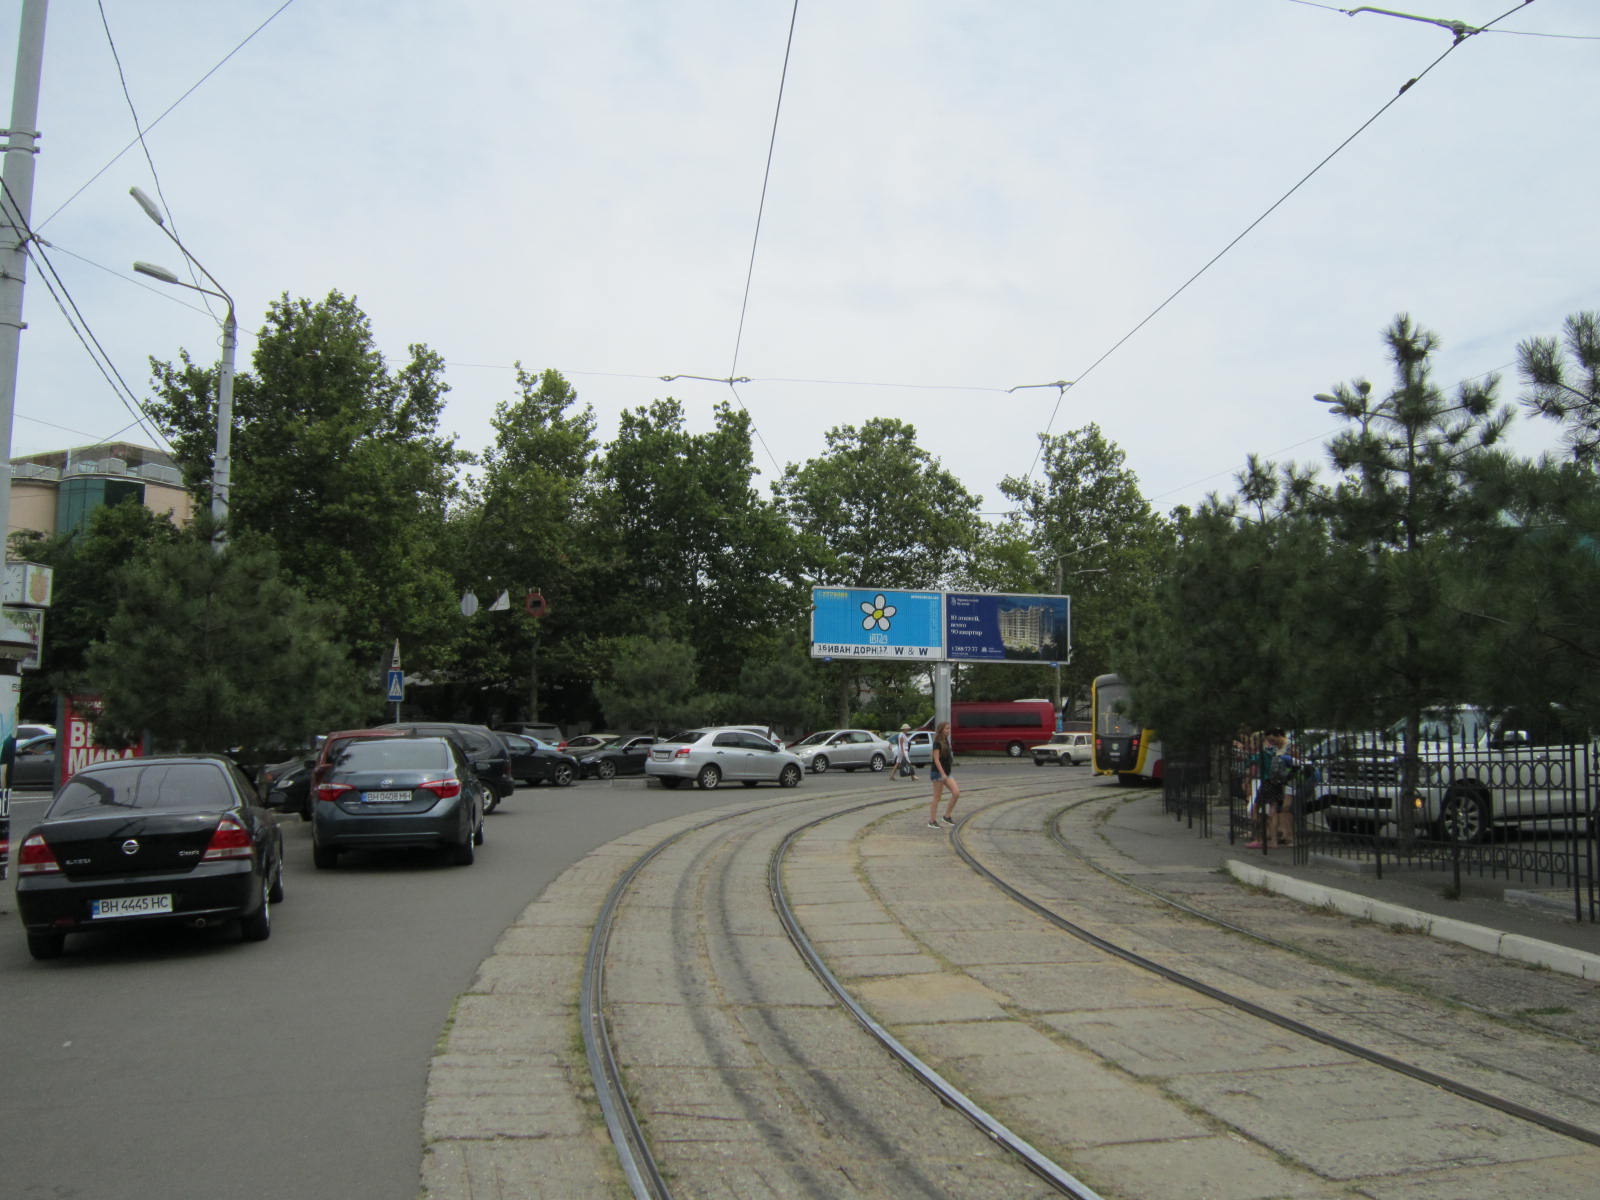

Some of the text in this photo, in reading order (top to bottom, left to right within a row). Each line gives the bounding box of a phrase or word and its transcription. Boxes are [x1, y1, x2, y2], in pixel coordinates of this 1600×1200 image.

[827, 645, 851, 654] ИВАН
[853, 646, 877, 655] ДОРН
[894, 647, 904, 655] W
[101, 896, 169, 913] BH 4445 HC
